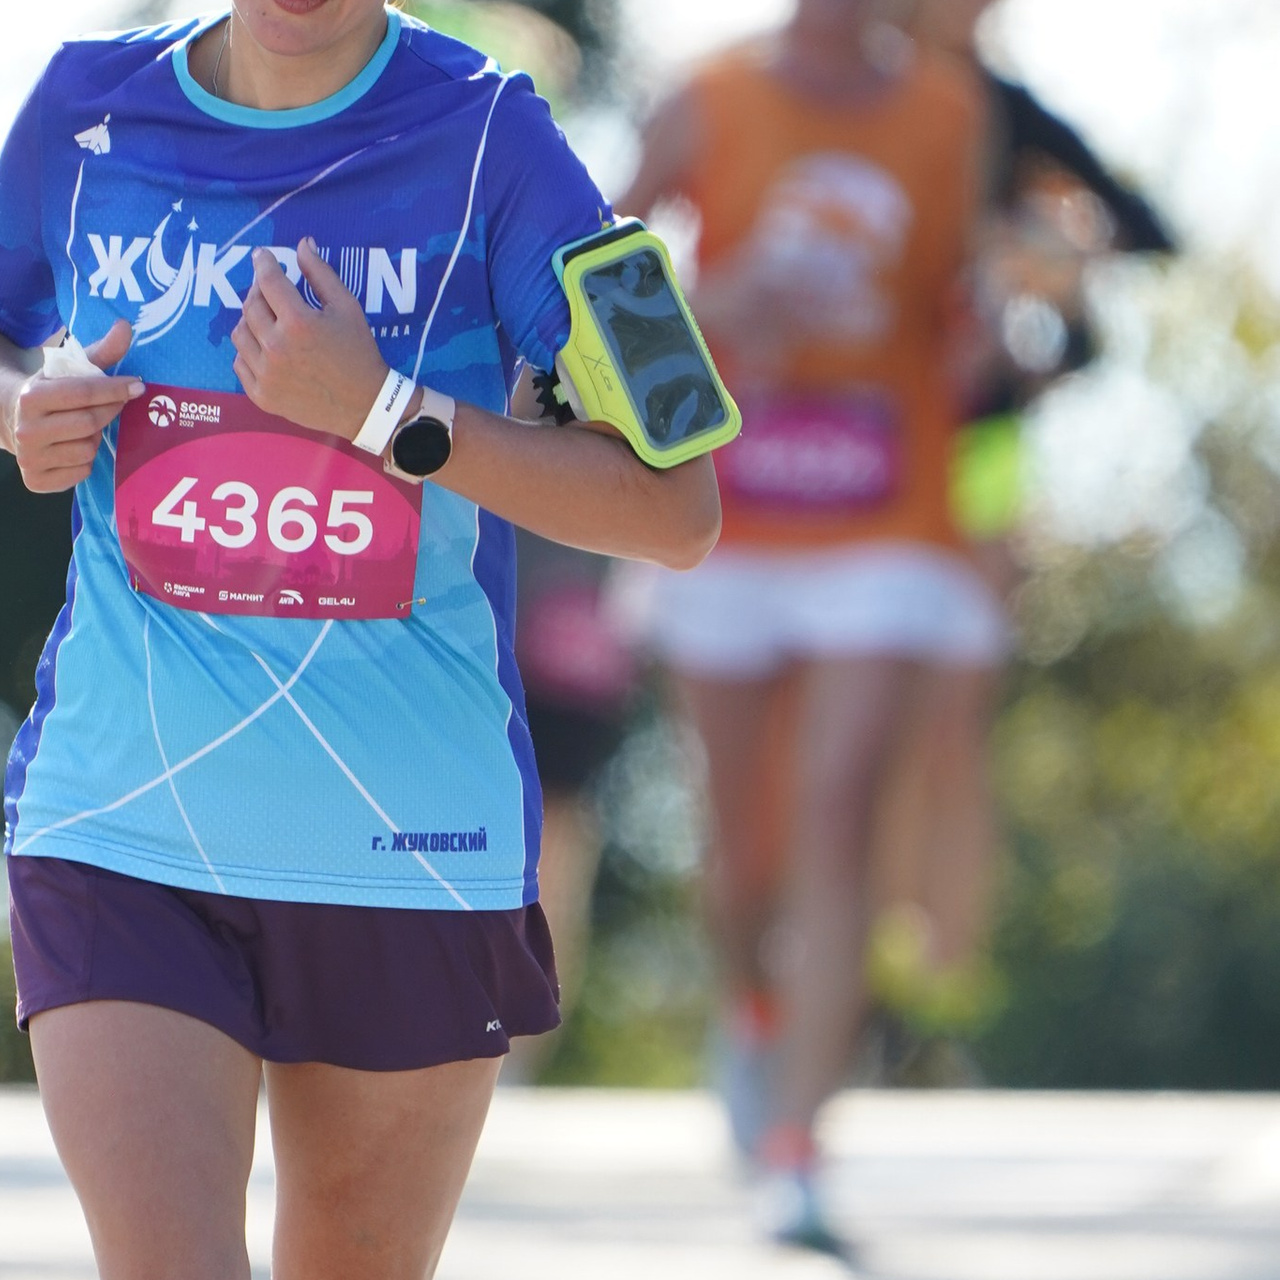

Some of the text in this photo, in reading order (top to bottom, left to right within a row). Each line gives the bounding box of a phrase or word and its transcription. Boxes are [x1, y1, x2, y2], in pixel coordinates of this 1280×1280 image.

[180, 401, 221, 417] SOCHI
[179, 412, 220, 424] MARATHON
[179, 419, 195, 428] 2022
[152, 476, 374, 555] 4365
[173, 583, 205, 595] ВЫСШАЯ
[173, 589, 191, 598] ЛИГА
[229, 592, 265, 602] МАГНИТ
[318, 597, 356, 606] GEL4U
[391, 826, 487, 852] ЖУКОВСКИЙ
